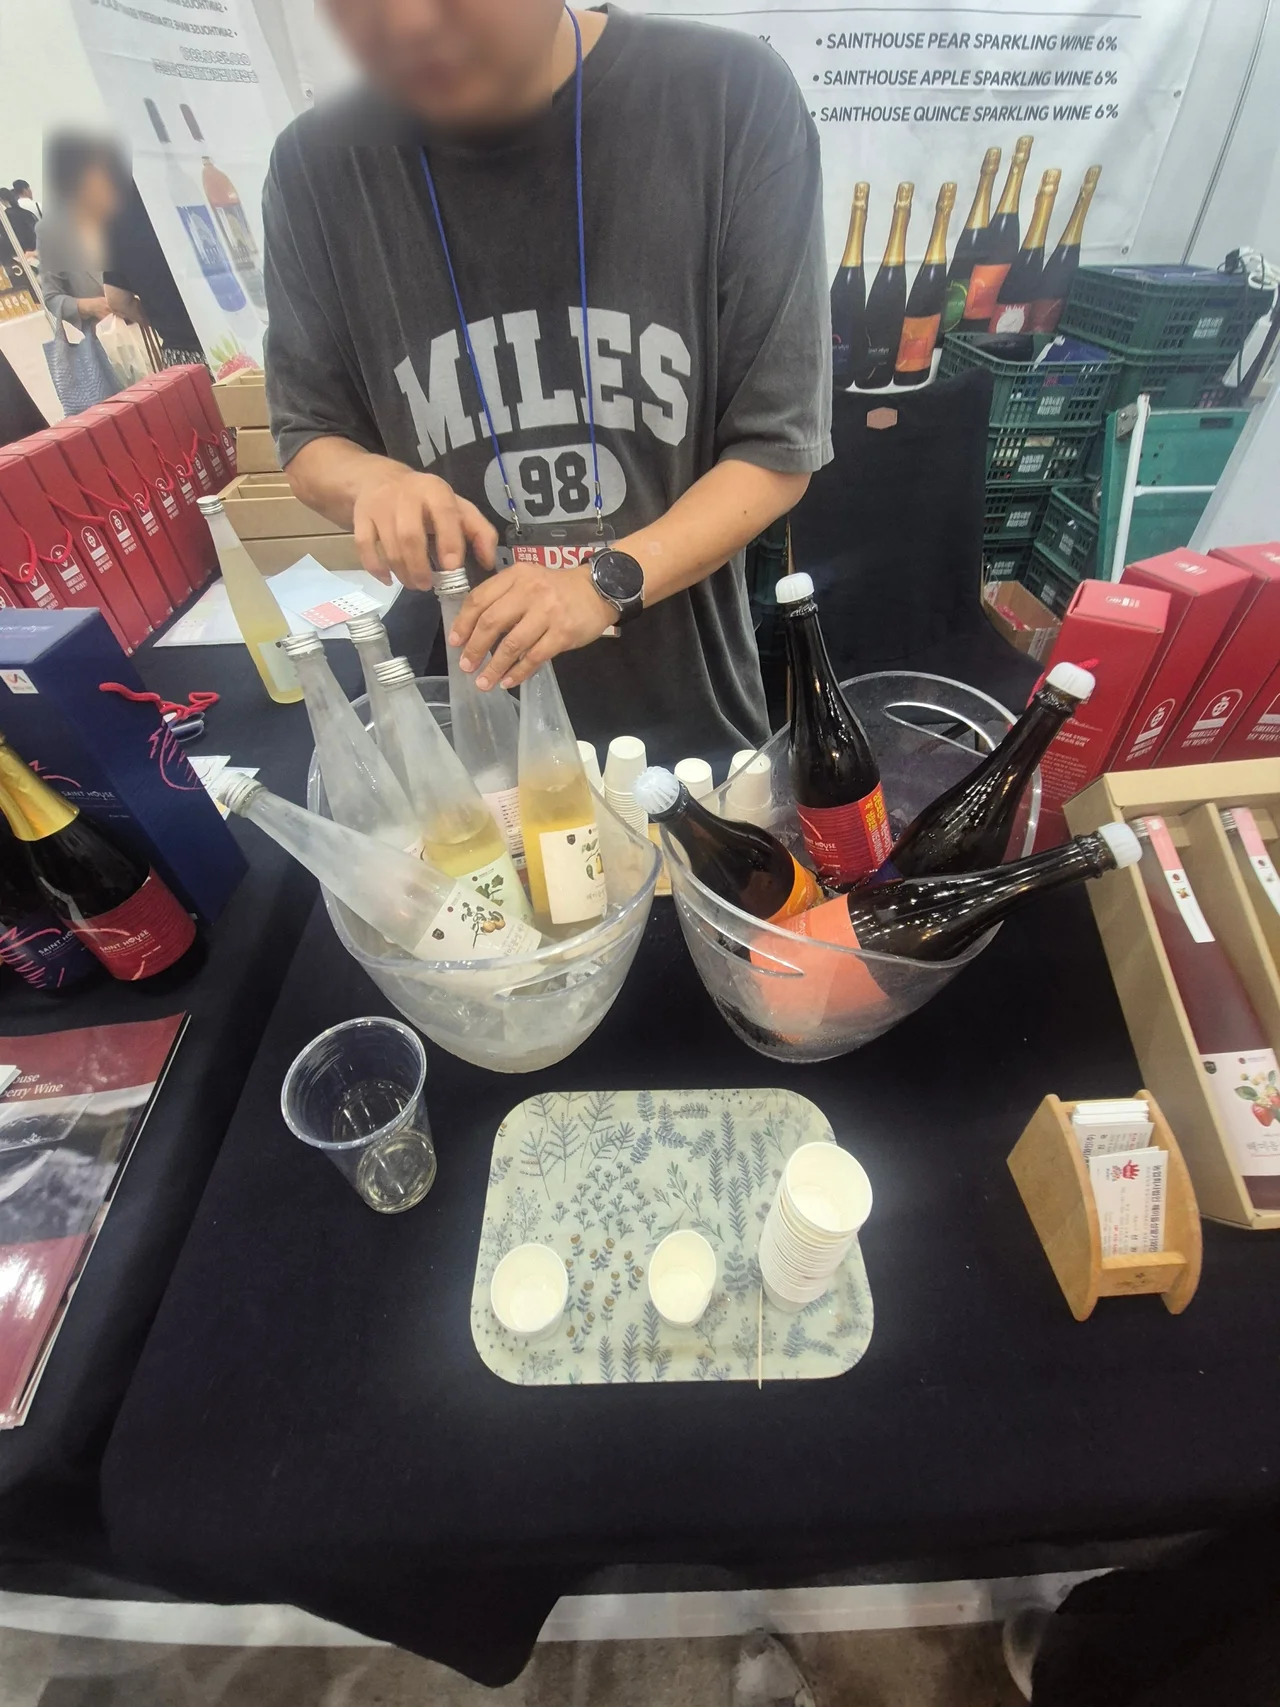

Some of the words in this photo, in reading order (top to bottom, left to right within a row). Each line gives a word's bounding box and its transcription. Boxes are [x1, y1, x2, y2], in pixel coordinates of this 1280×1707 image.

[826, 32, 926, 49] SAINTHOUSE
[927, 32, 971, 49] PEAR
[973, 33, 1057, 50] SPARKLING
[1060, 35, 1095, 51] WINE
[1096, 35, 1118, 51] 6%
[823, 70, 918, 86] SAINTHOUSE
[920, 70, 971, 86] APPLE
[973, 70, 1052, 86] SPARKLING
[1054, 70, 1093, 86] WINE
[1094, 70, 1118, 86] 6%
[820, 106, 915, 122] SAINTHOUSE
[913, 106, 971, 122] QUINCE
[973, 105, 1050, 122] SPARKLING
[1053, 104, 1092, 121] WINE
[1094, 103, 1119, 120] 6%
[393, 306, 691, 468] MILES
[518, 451, 591, 518] 98
[87, 790, 115, 801] HOUSE
[122, 929, 150, 943] HOUSE
[38, 939, 62, 955] SAINT
[13, 1073, 40, 1084] ouse
[34, 1082, 64, 1095] Wine
